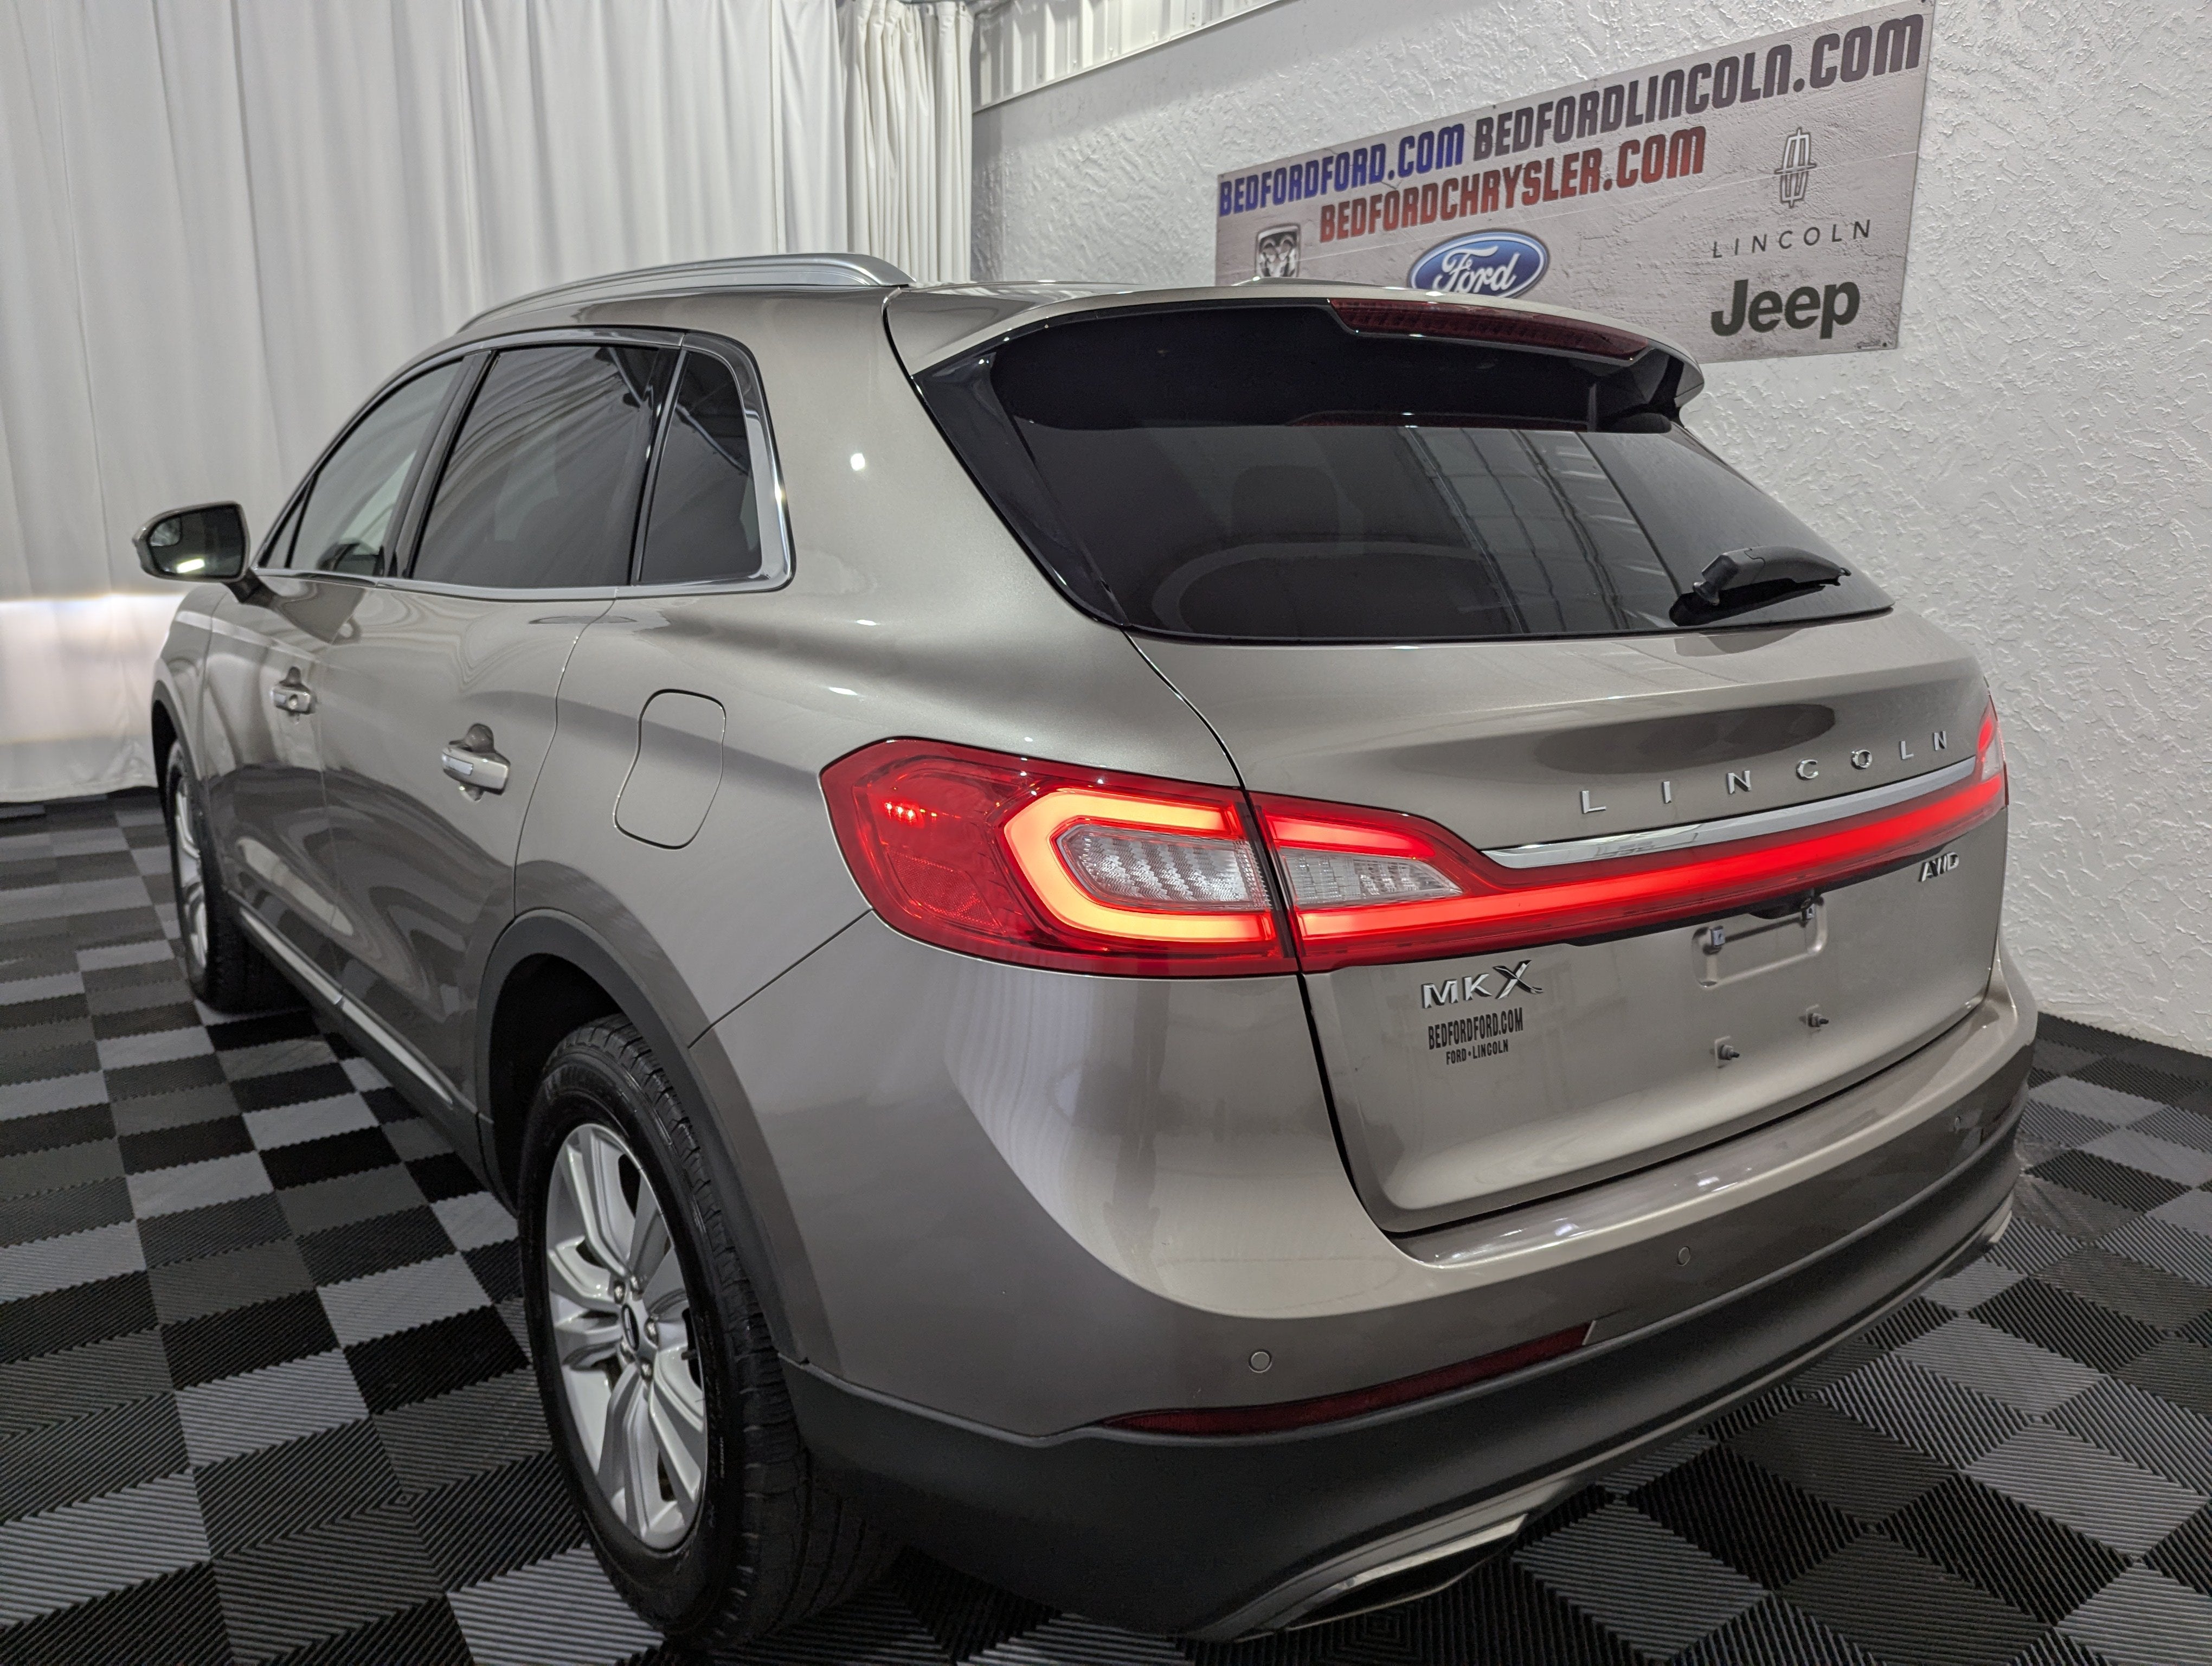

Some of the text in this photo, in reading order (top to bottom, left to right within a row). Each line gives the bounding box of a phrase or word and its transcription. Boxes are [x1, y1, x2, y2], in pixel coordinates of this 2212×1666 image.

[1219, 14, 1924, 217] BEDFORDFORD.COM BEDFORDLINCOLN.COM
[1320, 125, 1707, 243] BEDFORDCHRYSLER.COM
[1713, 219, 1870, 259] LINCOLN
[1432, 246, 1520, 293] Ford
[1711, 279, 1860, 339] Jeep
[1580, 731, 1947, 814] LINCOLN
[1918, 851, 1959, 882] AWD
[1421, 959, 1544, 1009] MKX
[1428, 1007, 1523, 1050] BEDFORDFORD.COM
